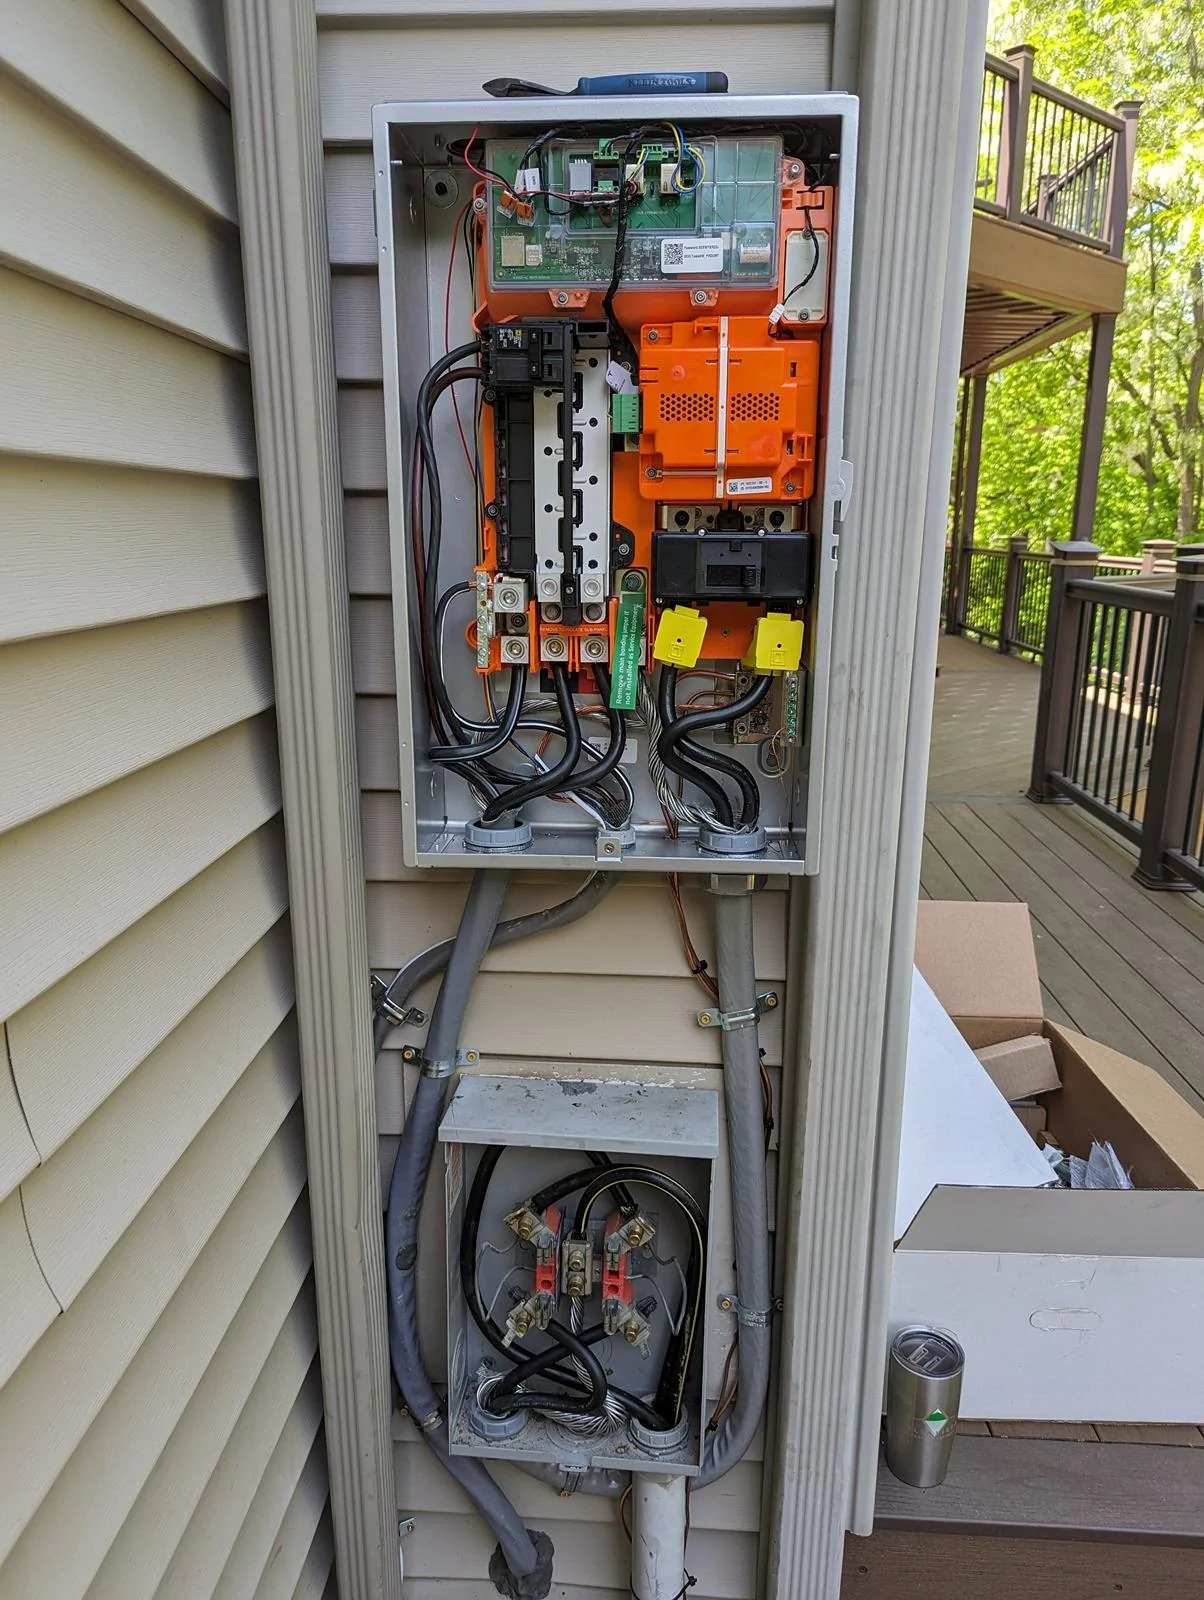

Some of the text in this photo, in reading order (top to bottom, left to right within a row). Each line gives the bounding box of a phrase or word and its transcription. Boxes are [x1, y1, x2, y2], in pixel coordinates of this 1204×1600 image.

[628, 78, 658, 88] KLEIN
[619, 633, 627, 656] bonding
[625, 660, 633, 691] installed
[616, 674, 624, 704] Remove
